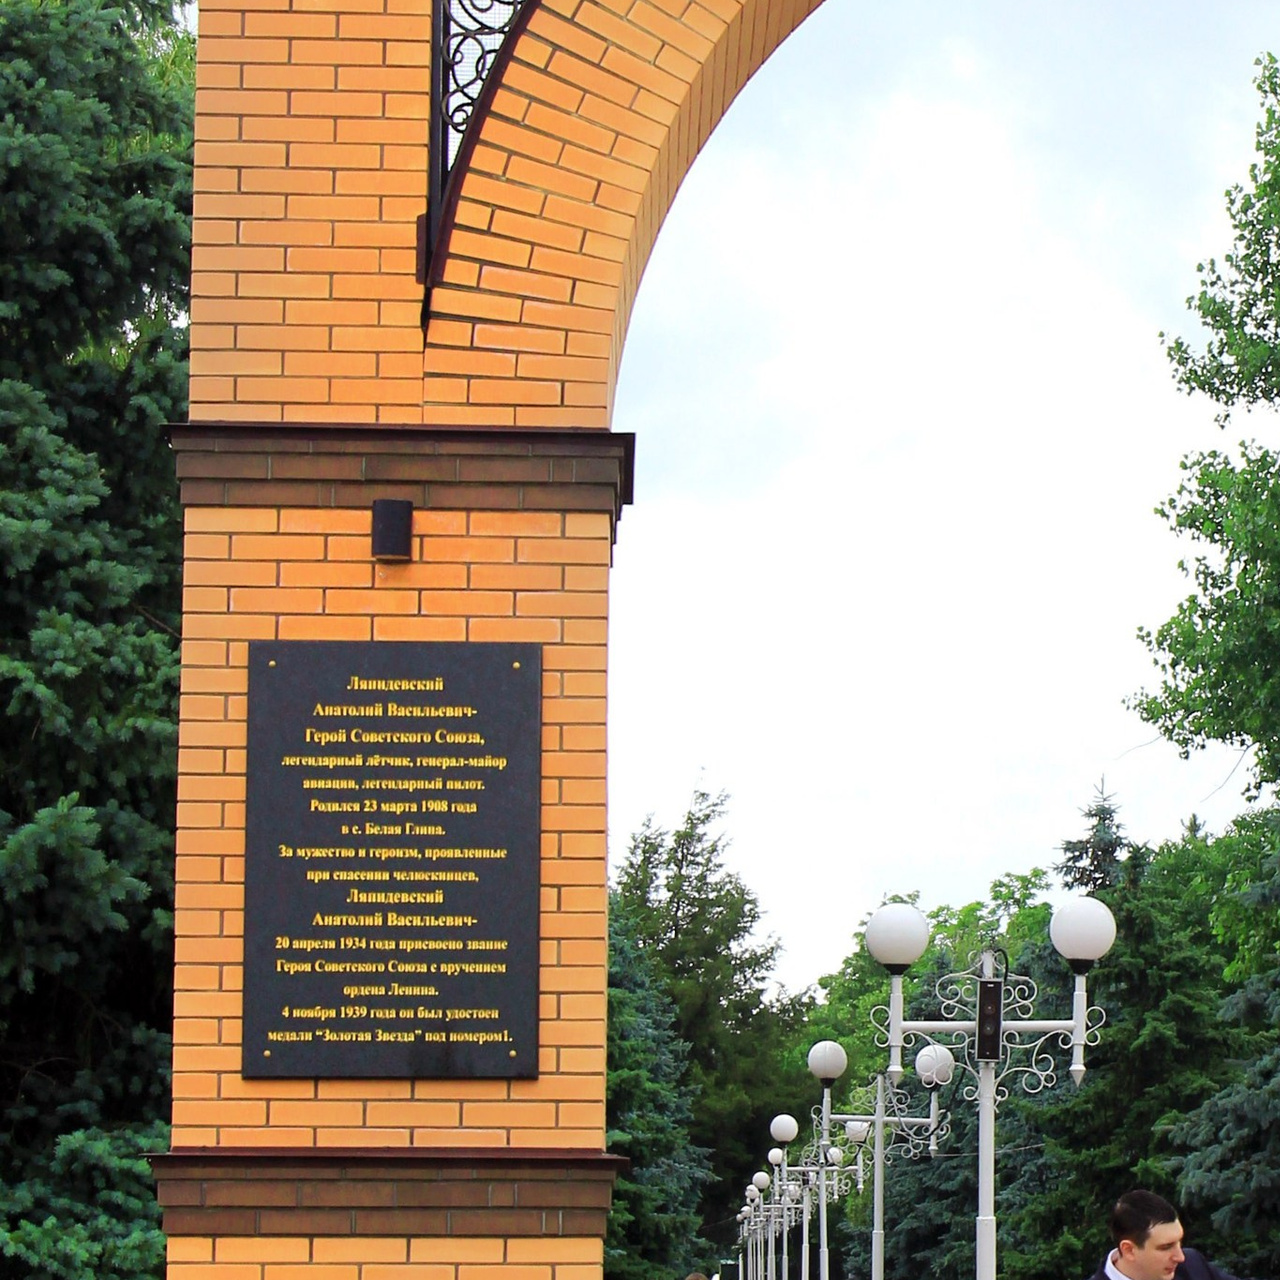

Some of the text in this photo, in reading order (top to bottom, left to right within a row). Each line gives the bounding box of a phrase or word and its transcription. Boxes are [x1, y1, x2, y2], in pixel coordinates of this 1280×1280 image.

[347, 676, 443, 692] Ляпидевский
[313, 703, 383, 717] Анатолий
[305, 728, 485, 747] Герой Советского Союза,
[281, 754, 507, 771] легендарный лётчик, генерал-майор
[302, 778, 485, 793] авиации, легендарный пилот.
[310, 799, 477, 816] Родился 23 марта 1908 года
[341, 822, 446, 836] в с. Белая Глина.
[279, 845, 507, 861] За мужество и героизм, проявленные
[306, 871, 479, 884] при спасении челюскинцев,
[346, 889, 443, 905] Ляпидевский
[312, 912, 382, 927] Анатолий
[275, 936, 508, 953] 20 апреля 1934 года присвоено звание
[276, 959, 506, 976] Героя Советского Союза с вручением
[342, 983, 438, 999] ордена Ленина.
[281, 1006, 499, 1022] 4 ноября 1939 года он был удостоен
[267, 1032, 312, 1043] медали
[424, 1032, 446, 1043] под
